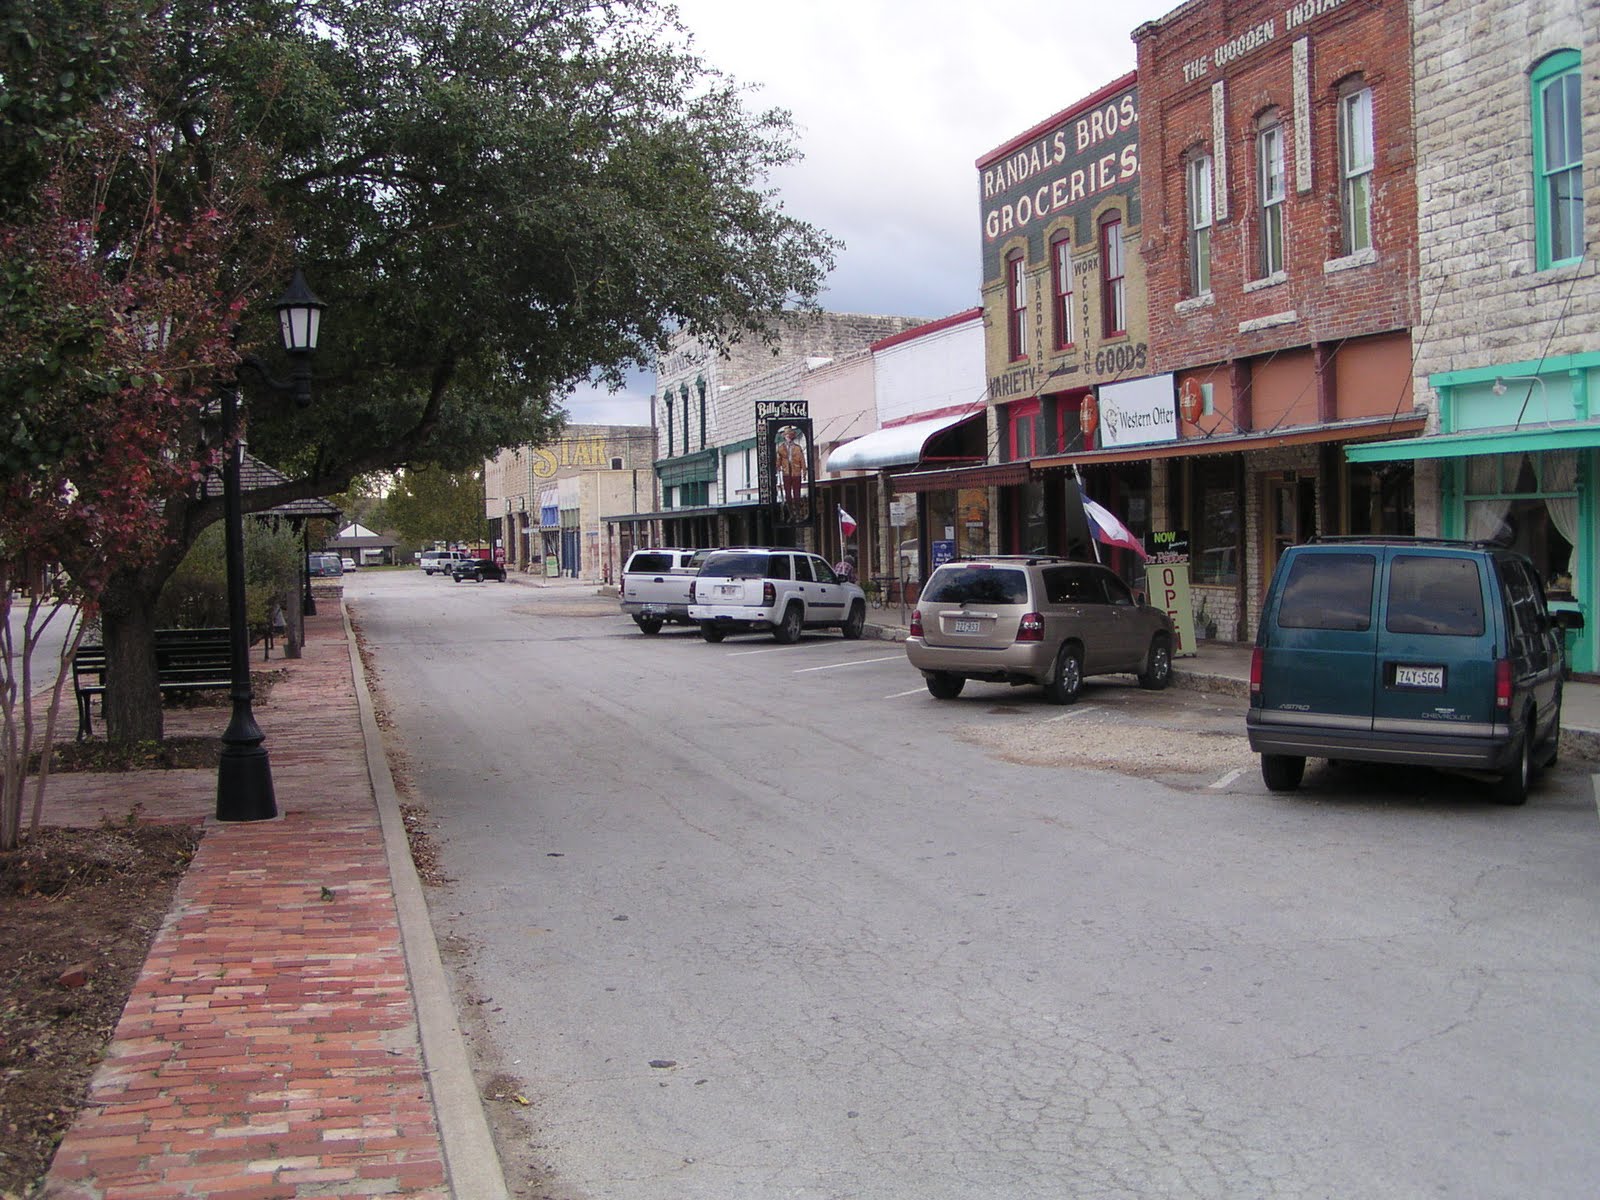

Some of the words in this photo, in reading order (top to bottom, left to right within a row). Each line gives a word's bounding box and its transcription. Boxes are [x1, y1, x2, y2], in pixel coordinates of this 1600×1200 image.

[1183, 55, 1207, 83] THE
[1214, 18, 1275, 67] WOODEN
[984, 131, 1067, 198] RANDALS
[1077, 95, 1138, 151] BROS.
[1074, 257, 1099, 277] WORK
[1035, 278, 1044, 375] HARDWARE
[1082, 277, 1092, 375] CLOTHING
[1095, 342, 1147, 376] GOODS
[989, 367, 1036, 398] VARIETY
[757, 402, 780, 418] Billy
[789, 403, 807, 416] Kid
[1119, 410, 1152, 430] Western
[1152, 406, 1174, 426] Otter
[1154, 532, 1176, 543] NOW
[1421, 712, 1472, 720] CHEVROLET
